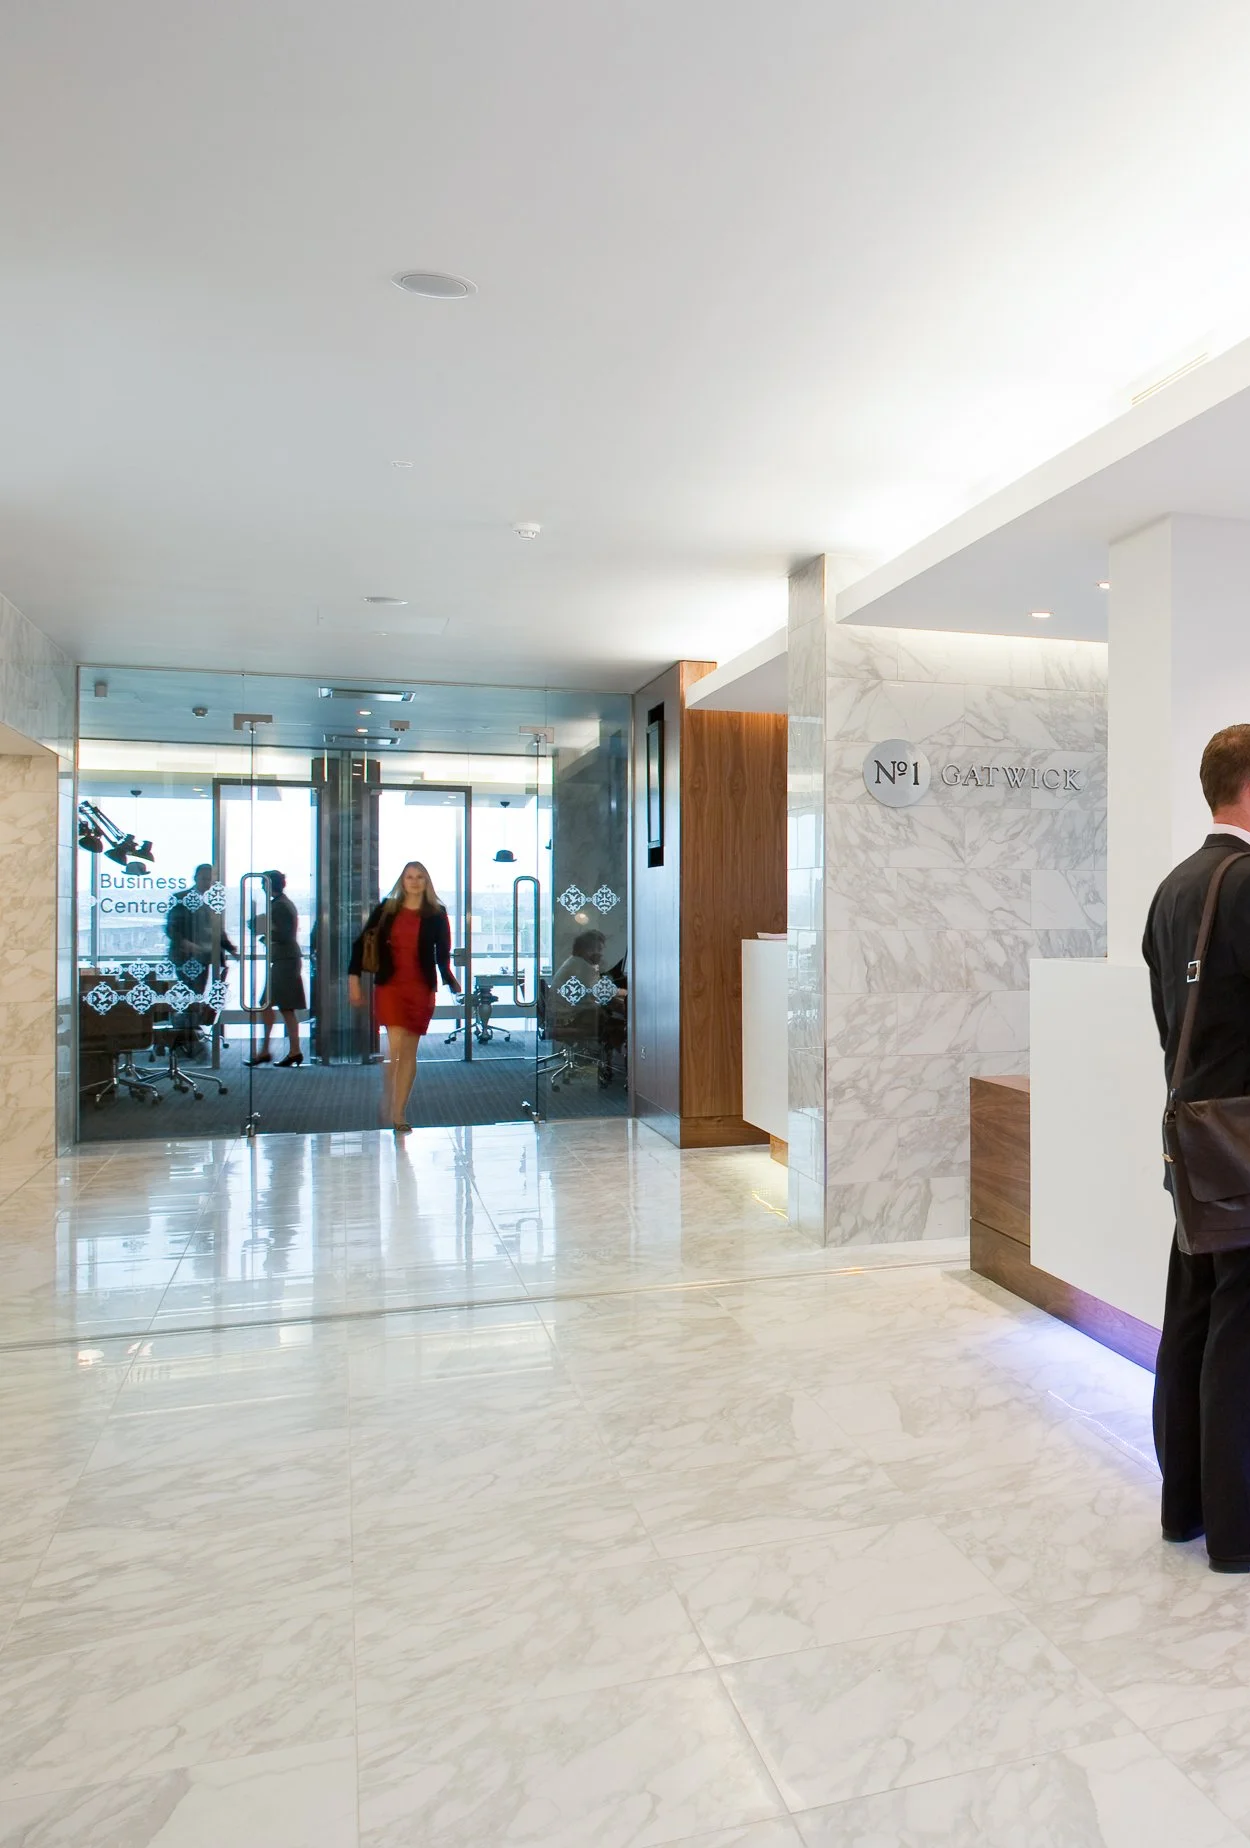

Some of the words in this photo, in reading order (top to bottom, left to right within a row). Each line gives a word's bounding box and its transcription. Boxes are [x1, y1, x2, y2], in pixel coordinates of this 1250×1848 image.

[941, 764, 1082, 791] GATWICK
[100, 873, 187, 889] Business
[100, 897, 168, 914] Centre
